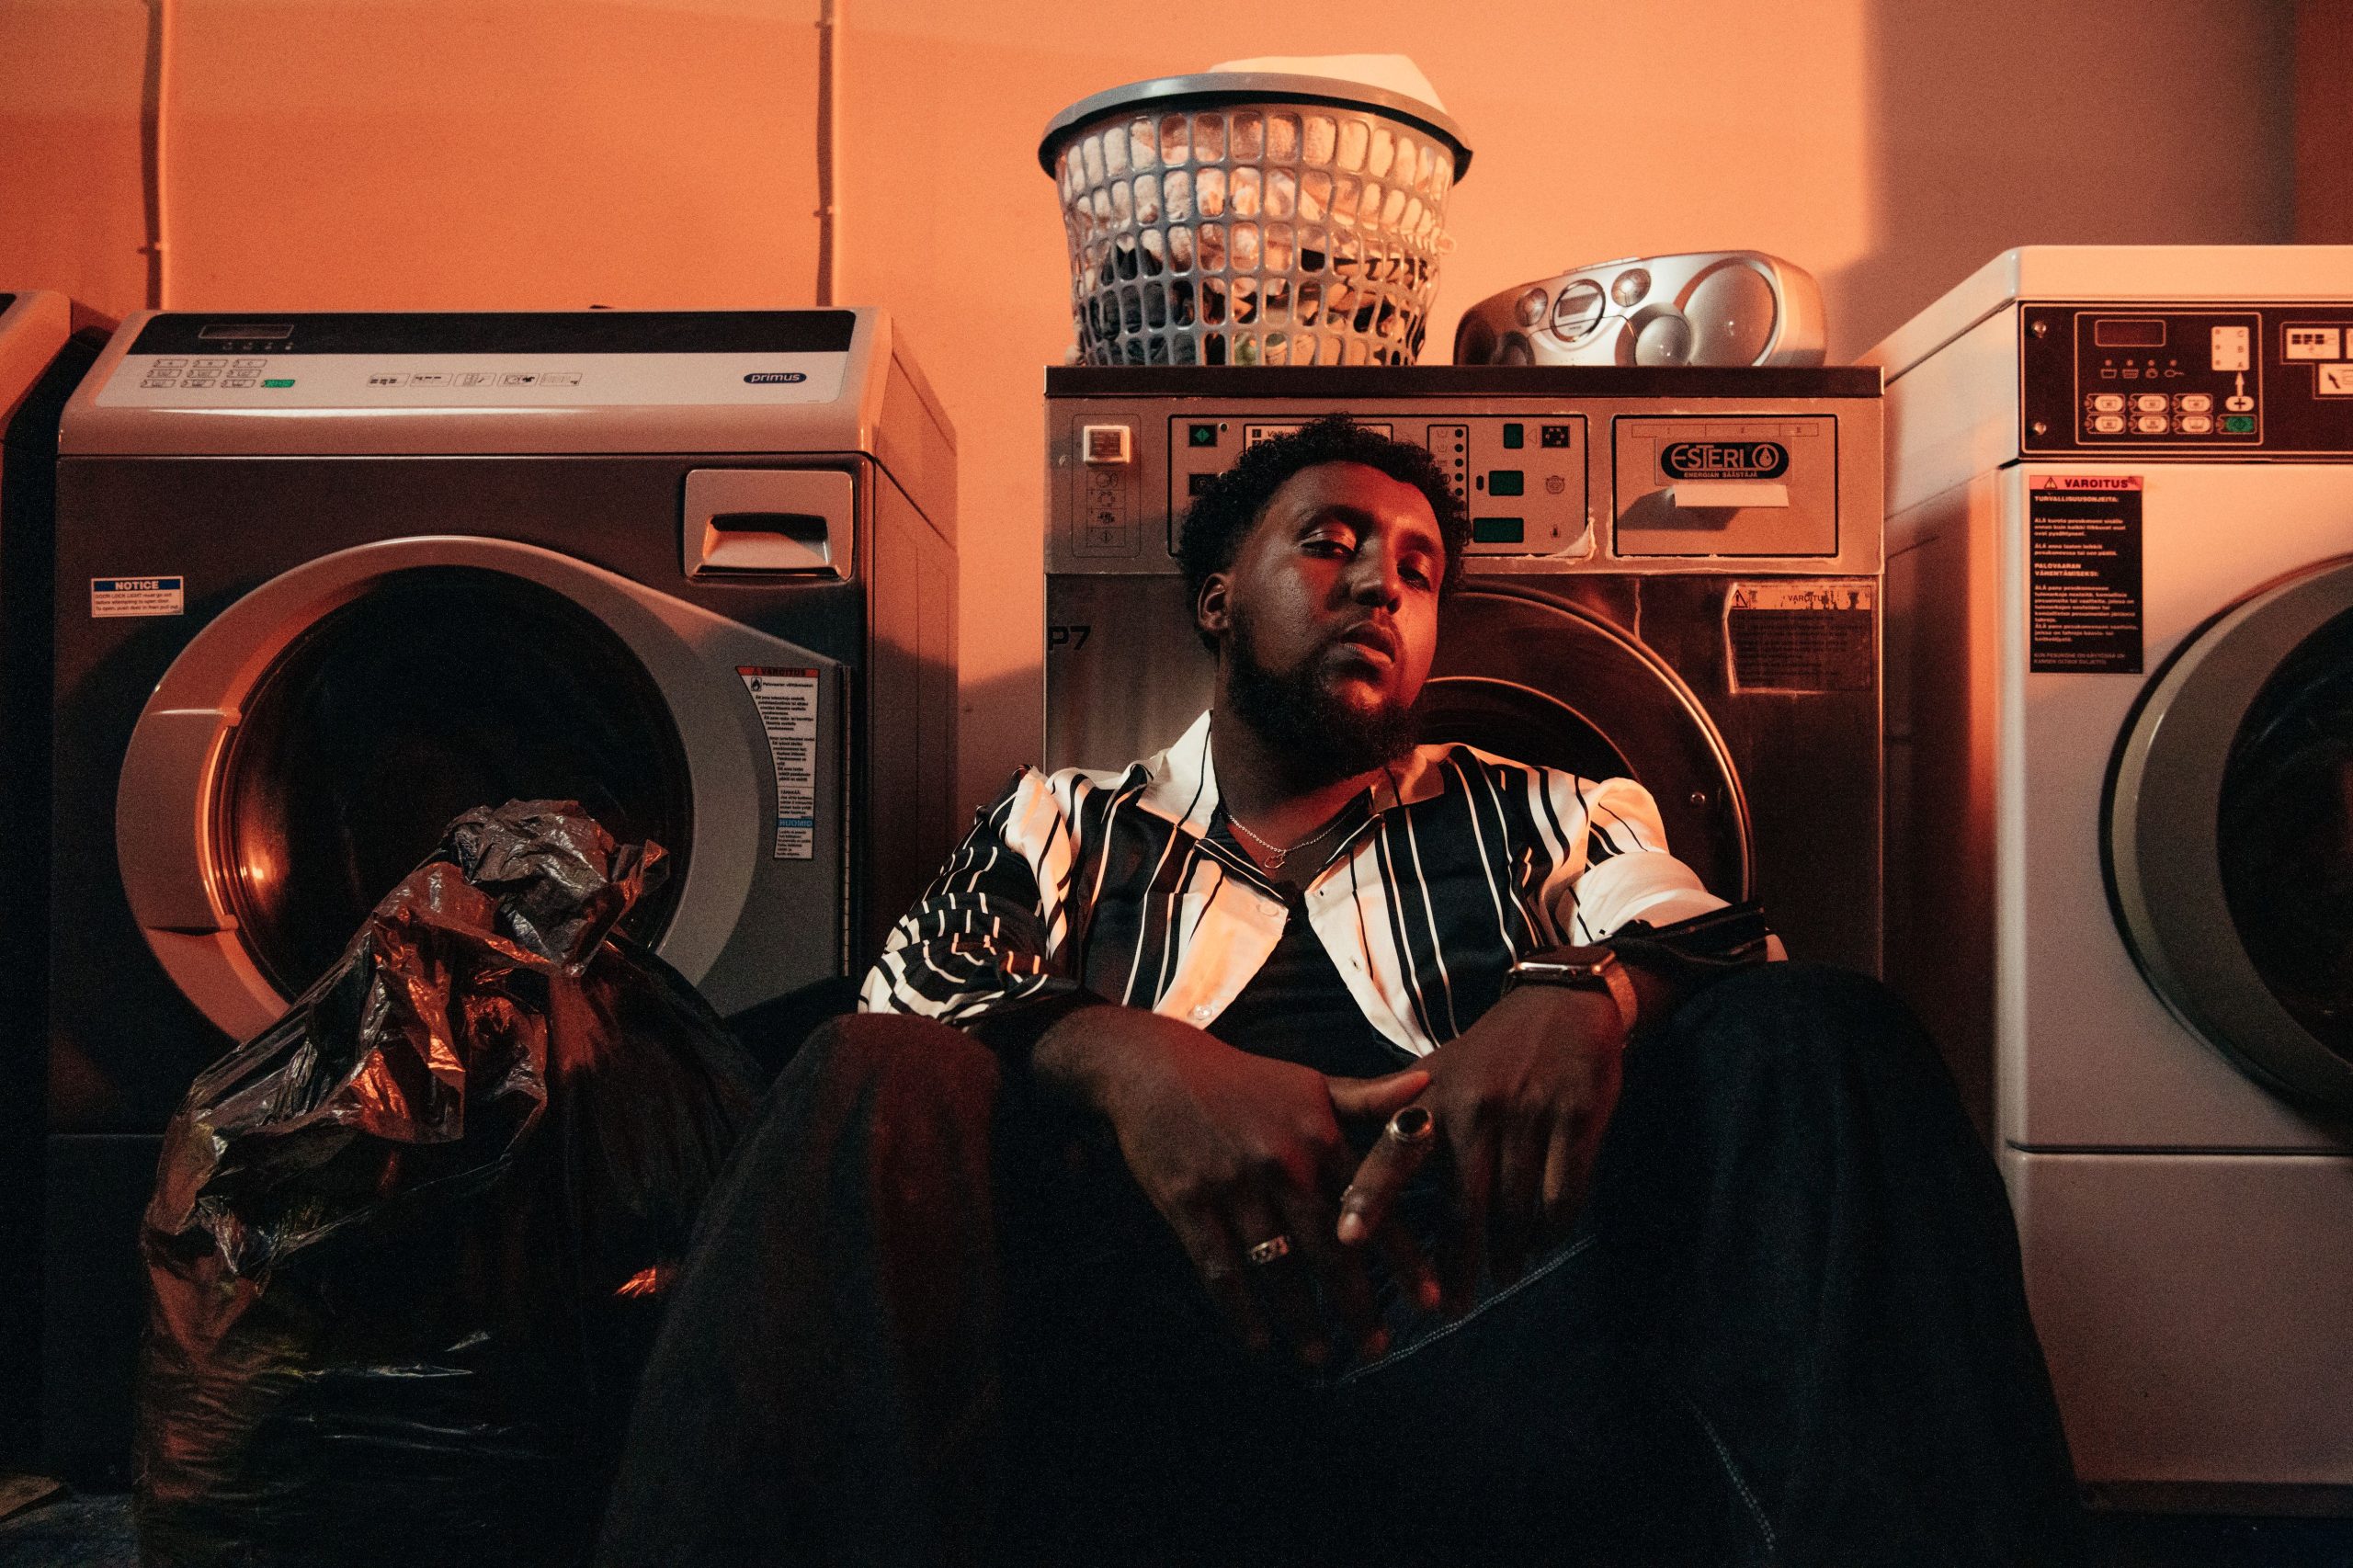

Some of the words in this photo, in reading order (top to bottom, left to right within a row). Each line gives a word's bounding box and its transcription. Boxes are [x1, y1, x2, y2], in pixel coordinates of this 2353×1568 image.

[751, 373, 801, 383] primus
[2064, 479, 2129, 488] VAROITUS
[115, 580, 160, 590] NOTICE
[1048, 626, 1091, 651] P7
[779, 819, 813, 827] HUOMIO
